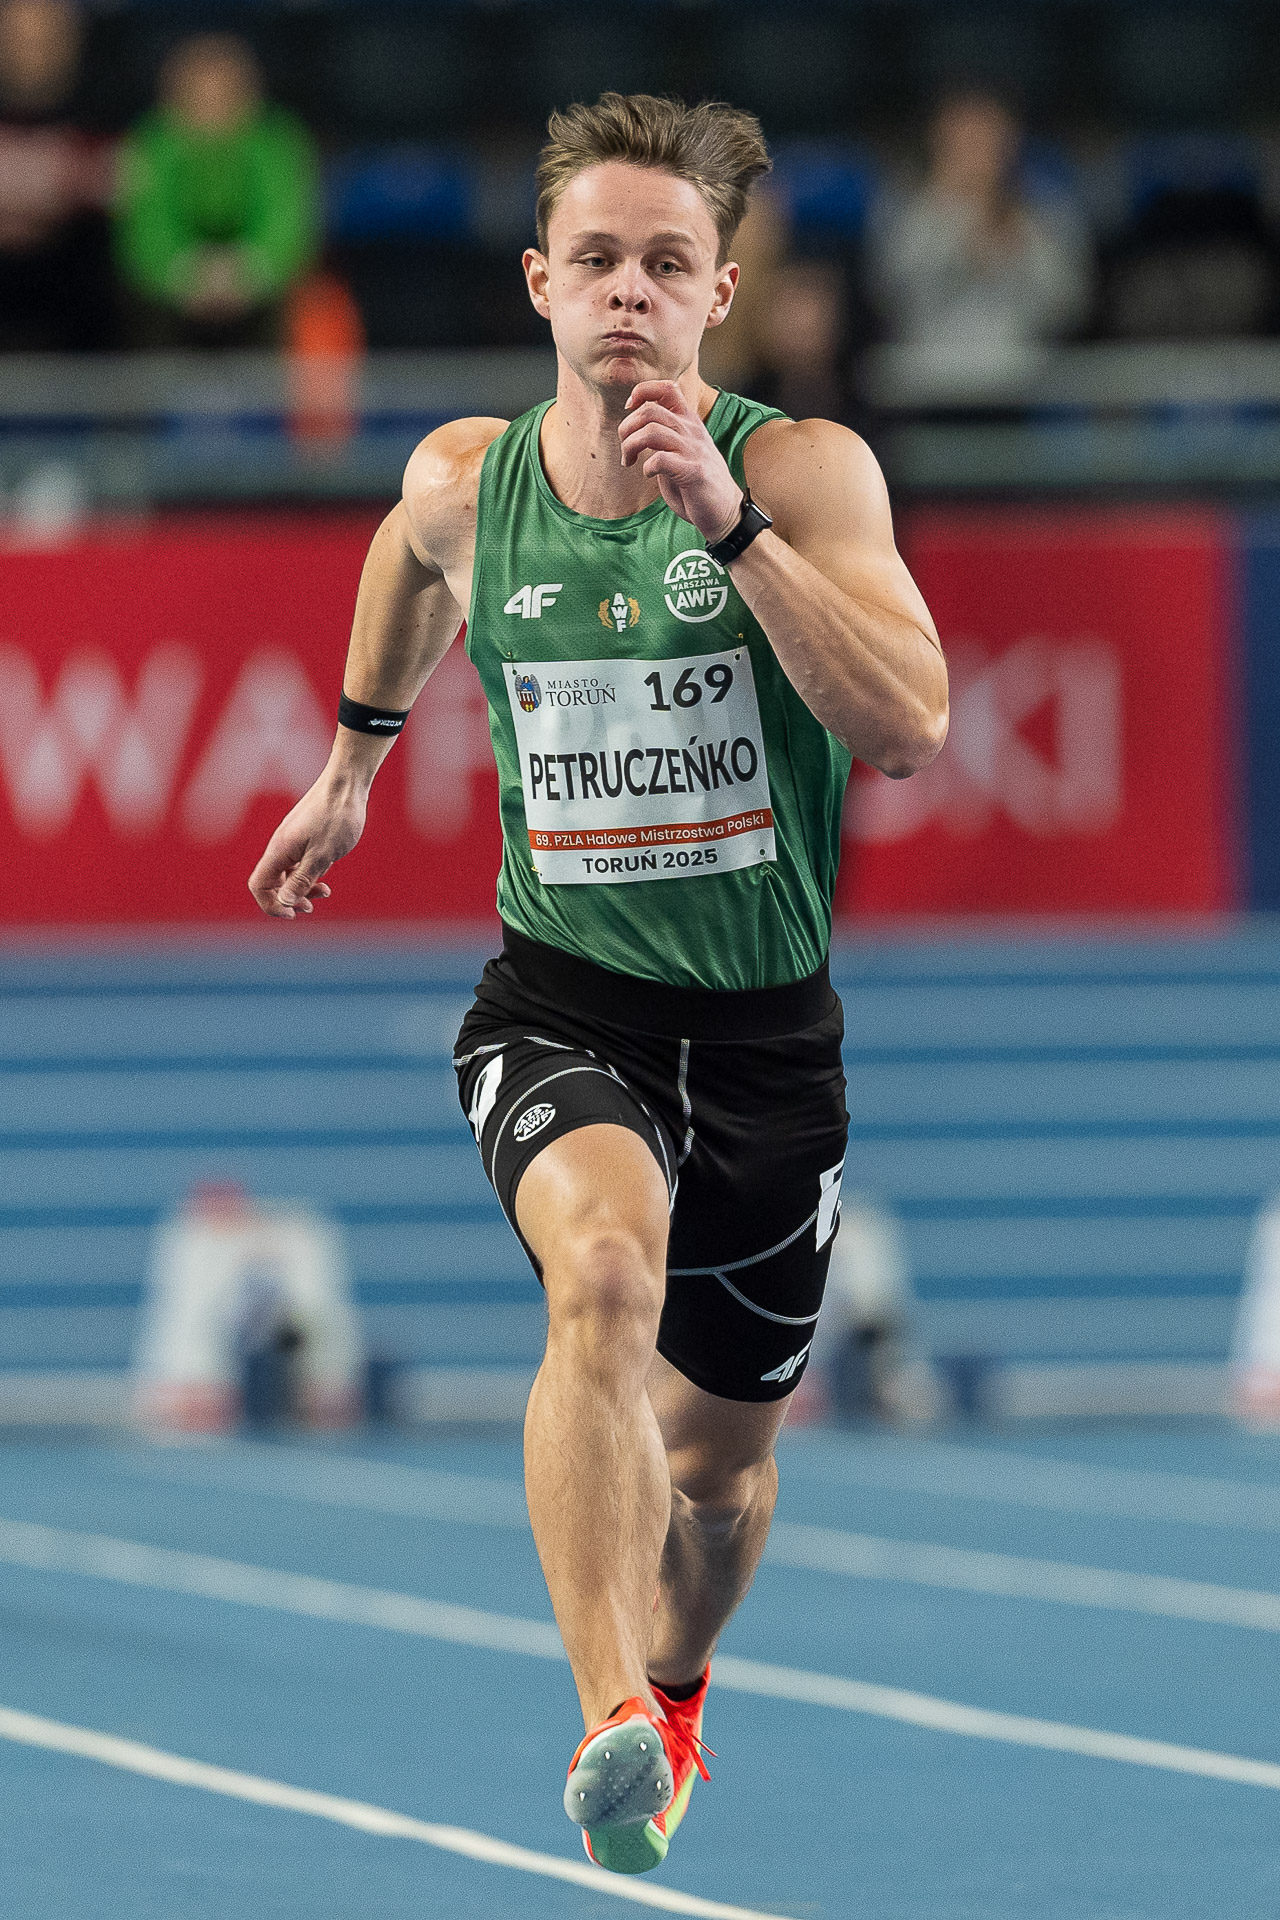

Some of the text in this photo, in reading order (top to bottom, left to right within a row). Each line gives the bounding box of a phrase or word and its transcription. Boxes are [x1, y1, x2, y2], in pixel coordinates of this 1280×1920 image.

[675, 559, 711, 582] AZS
[670, 577, 720, 592] WARSZAWA
[503, 583, 563, 619] 4F
[676, 586, 720, 610] AWF
[545, 683, 616, 707] TORUŃ
[547, 678, 599, 690] MIASTO
[643, 663, 734, 712] 169
[528, 735, 758, 801] PETRUCZEŃKO
[535, 812, 765, 847] 69. PZLA Halowe Mistrzostwa Polski
[581, 847, 718, 874] TORUŃ 2025
